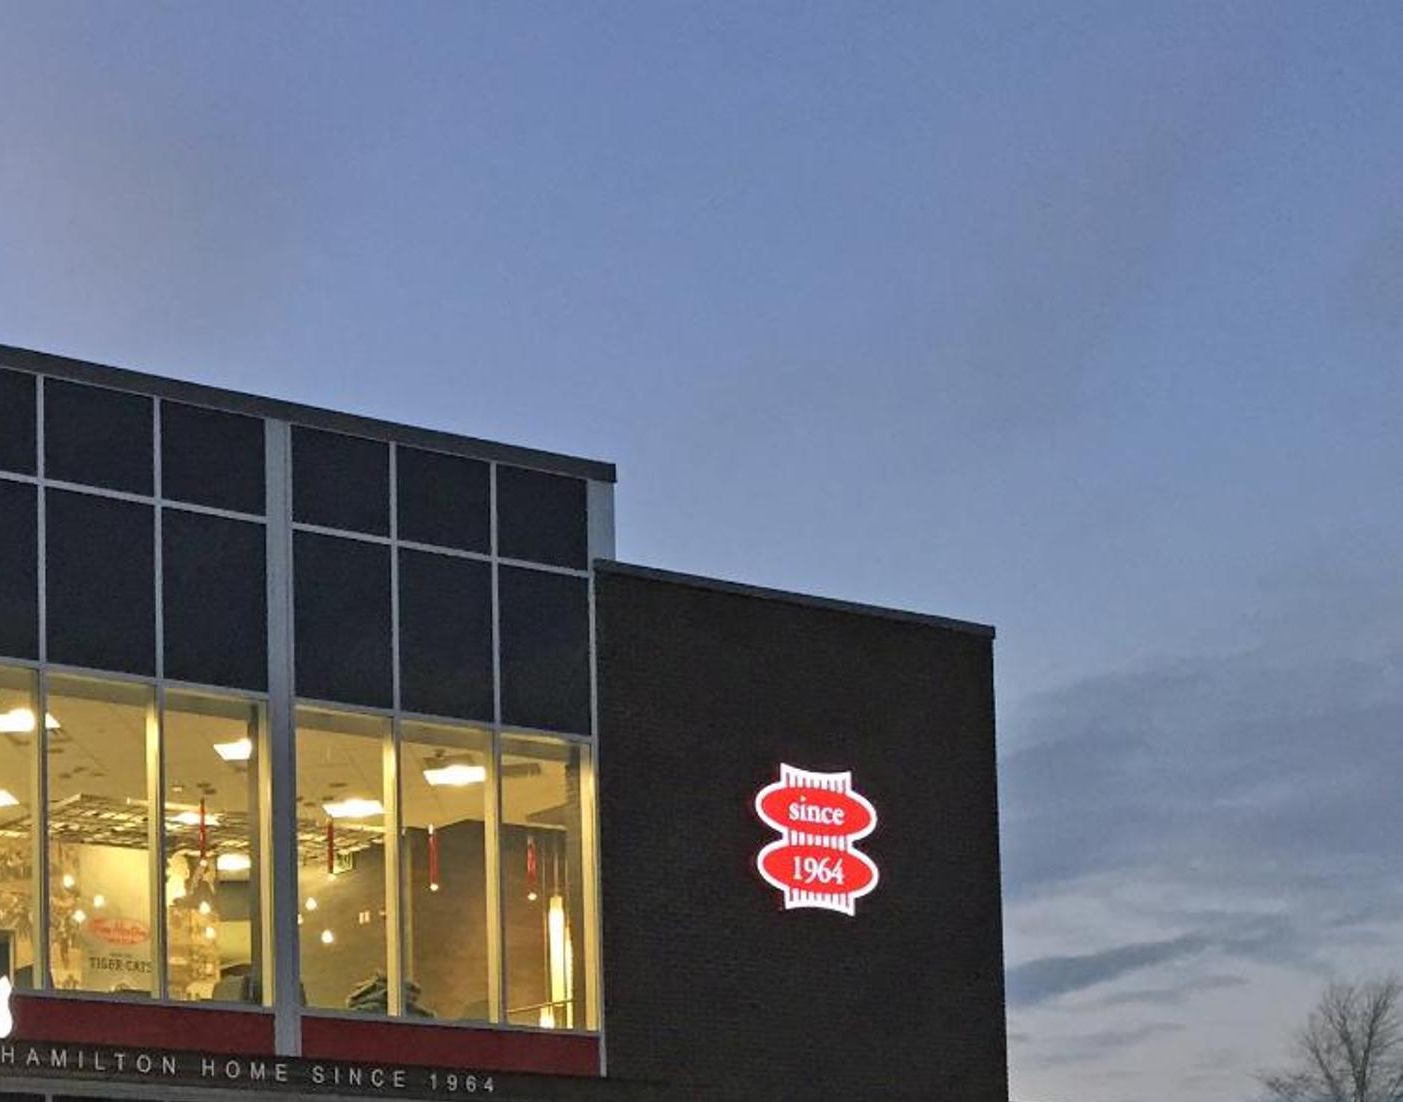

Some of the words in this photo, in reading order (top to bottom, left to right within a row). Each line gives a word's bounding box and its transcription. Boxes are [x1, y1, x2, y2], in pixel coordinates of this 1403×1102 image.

[788, 795, 845, 826] since
[793, 855, 845, 885] 1964
[1, 1045, 178, 1077] HAMILTON
[201, 1058, 289, 1083] HOME
[311, 1064, 406, 1089] SINCE
[429, 1072, 497, 1093] 1964
